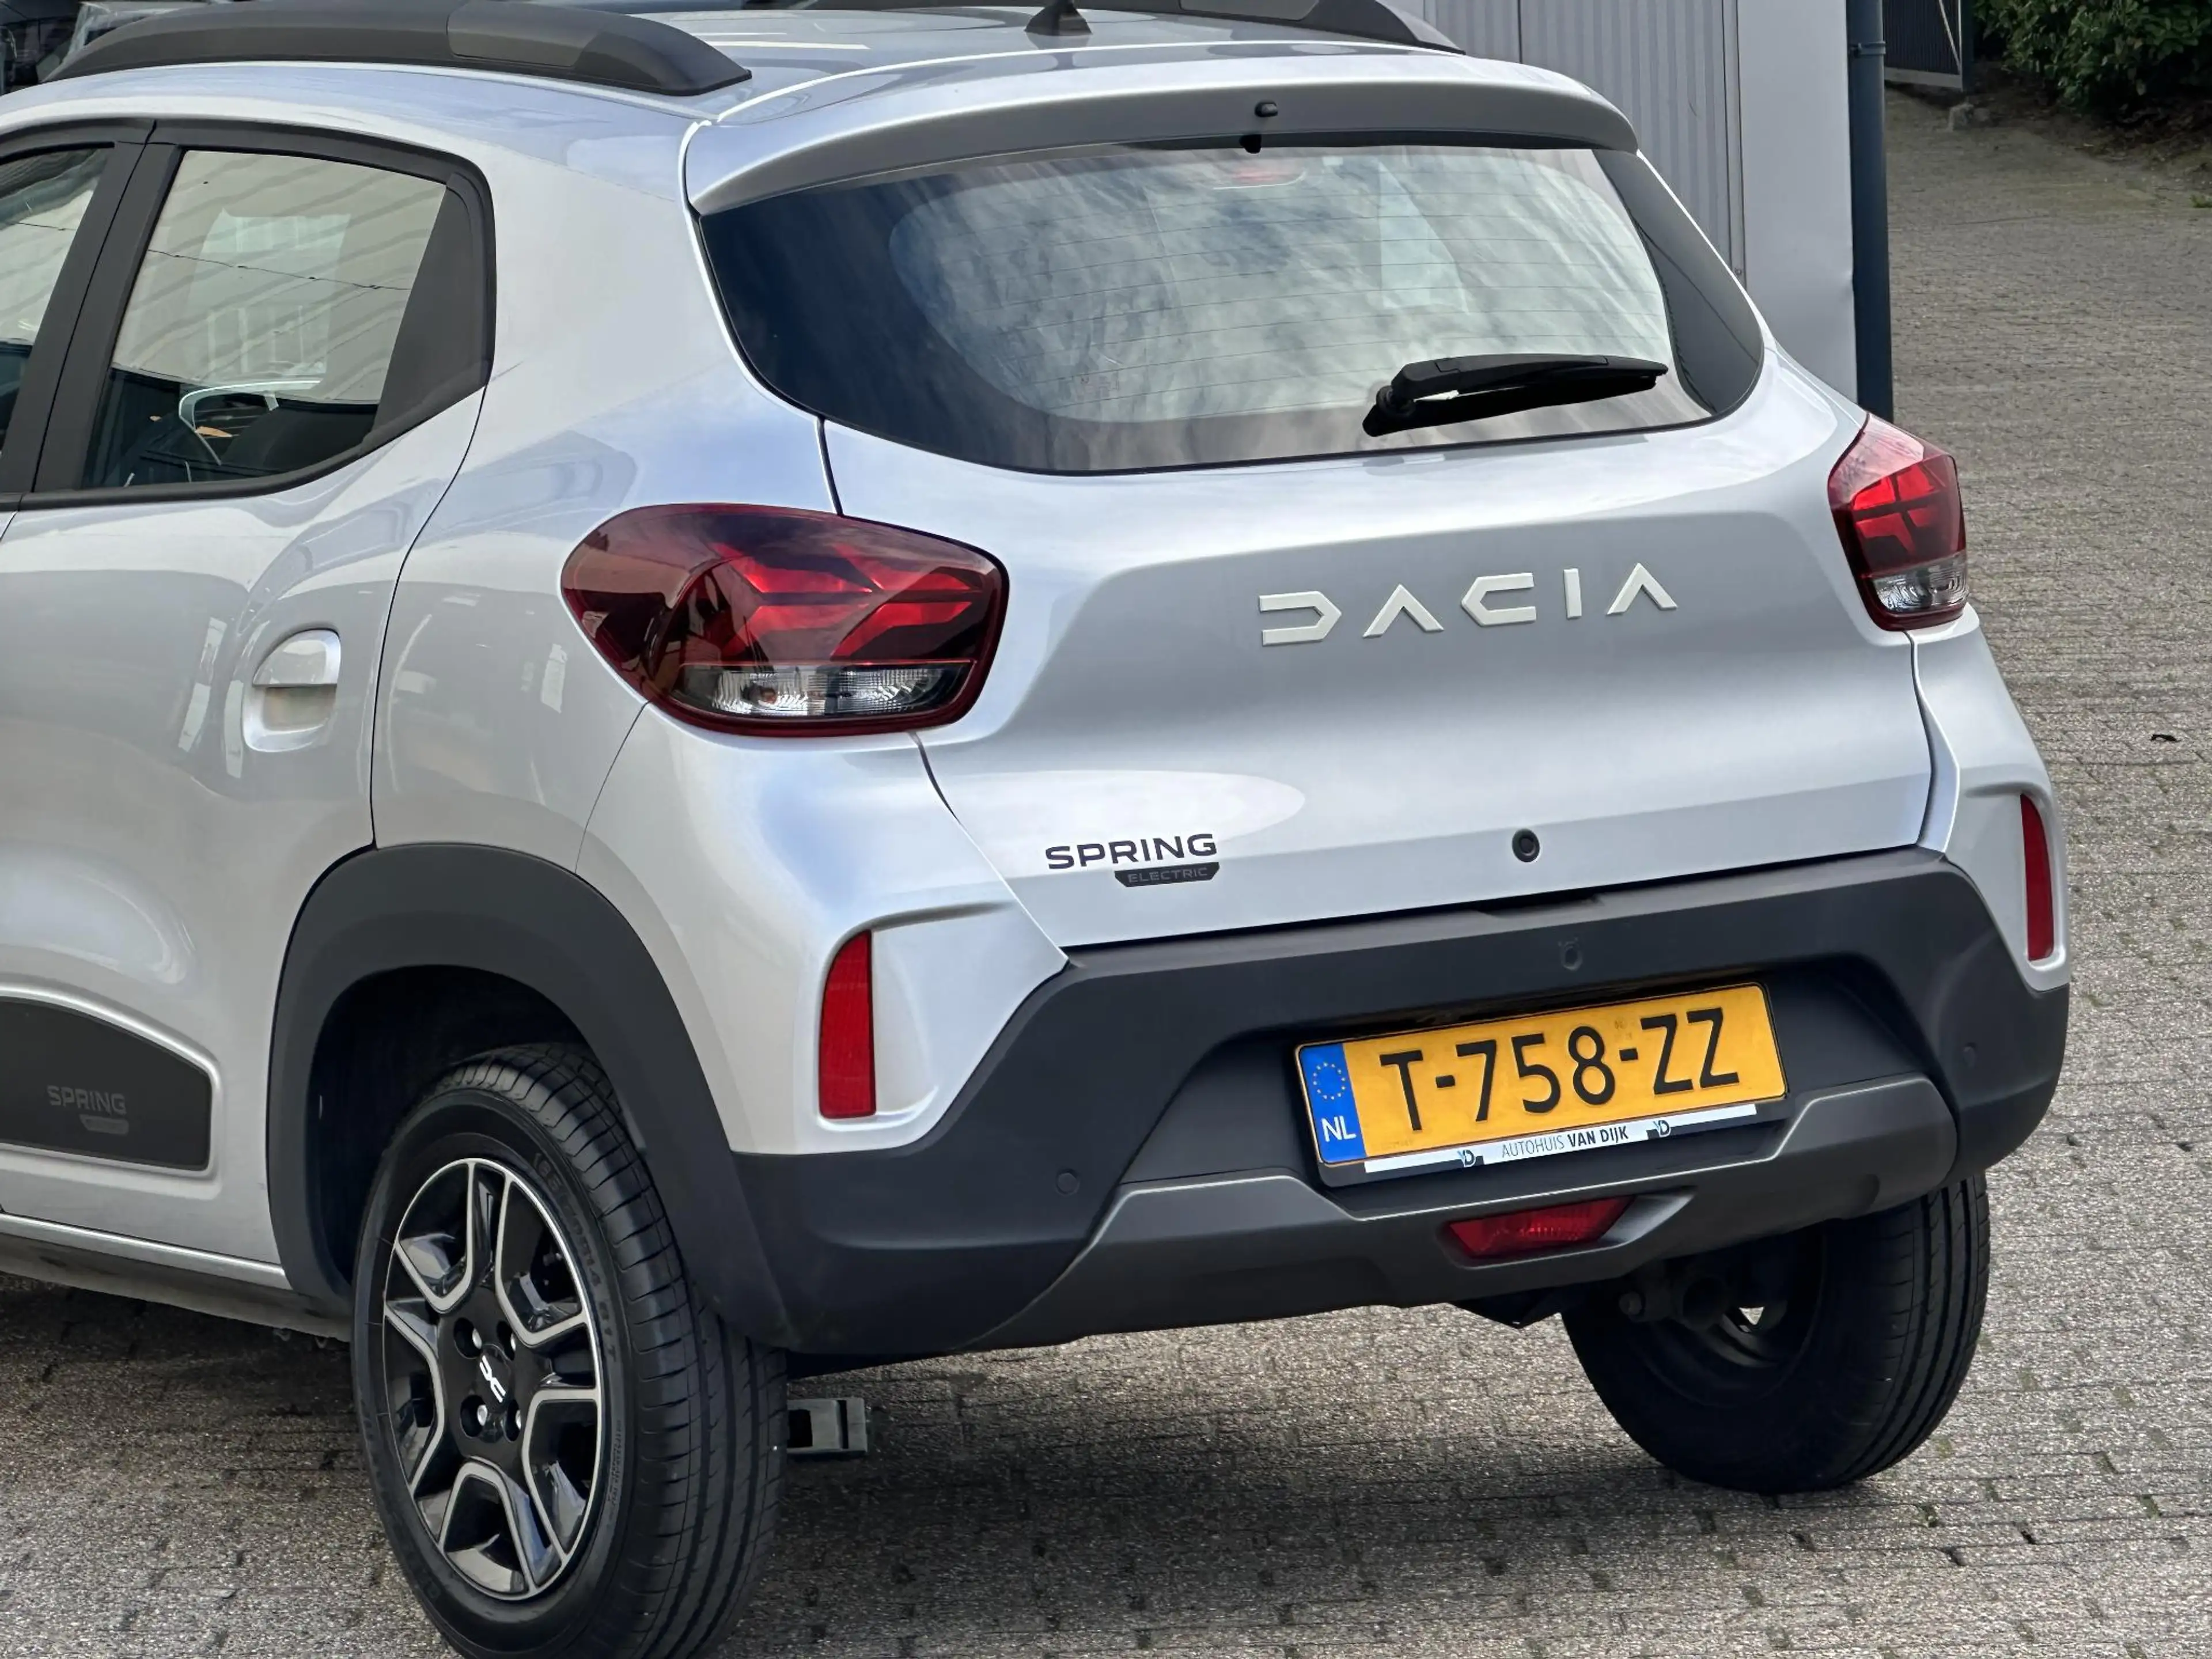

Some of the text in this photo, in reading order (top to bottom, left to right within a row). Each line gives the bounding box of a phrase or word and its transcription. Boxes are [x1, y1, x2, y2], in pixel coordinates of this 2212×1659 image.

[1259, 562, 1679, 646] DACIA
[1045, 834, 1217, 869] SPRING
[1127, 866, 1209, 884] ELECTRIC
[1378, 1006, 1740, 1132] T-758-ZZ
[47, 1085, 127, 1116] SPRING
[1321, 1115, 1357, 1142] NL
[1501, 1134, 1565, 1158] AUTOHUIS
[1567, 1130, 1597, 1148] VAN
[1599, 1125, 1629, 1143] DIJK
